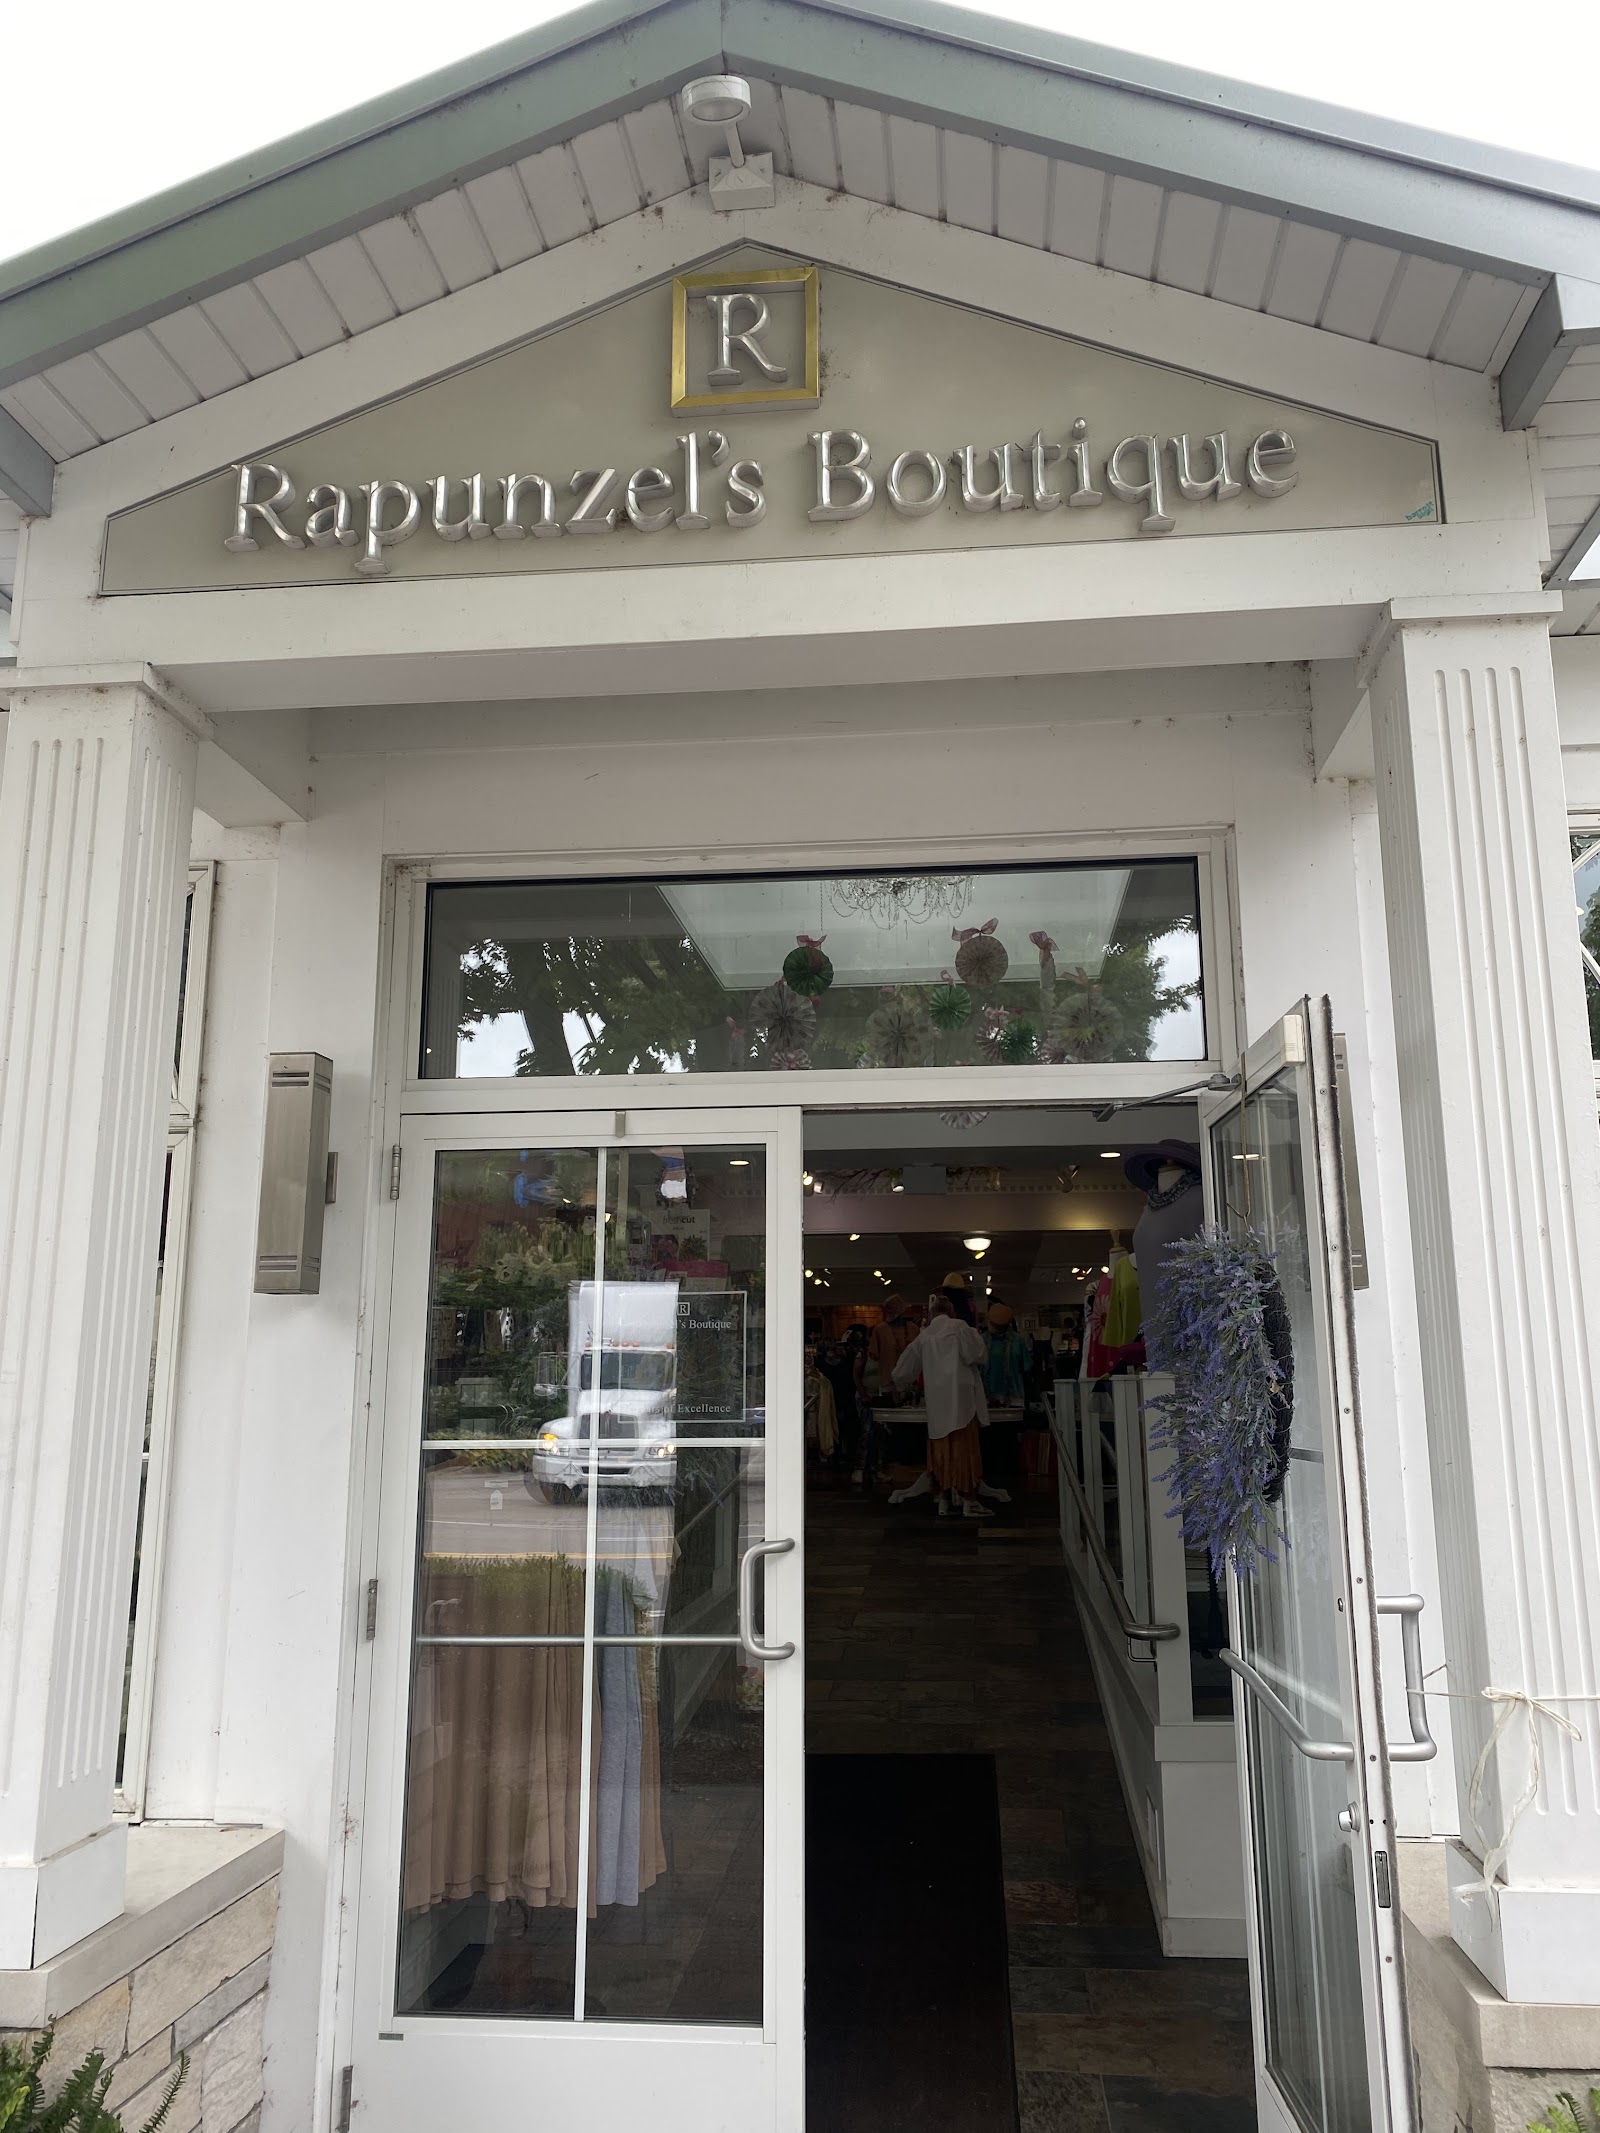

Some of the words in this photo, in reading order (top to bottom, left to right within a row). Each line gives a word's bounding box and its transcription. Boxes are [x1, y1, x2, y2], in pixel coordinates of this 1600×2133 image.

[706, 292, 787, 386] R
[224, 429, 767, 575] Rapunzel's
[806, 417, 1299, 531] Boutique
[679, 1304, 687, 1313] R
[689, 1319, 732, 1331] Boutique
[678, 1404, 731, 1414] Excellence
